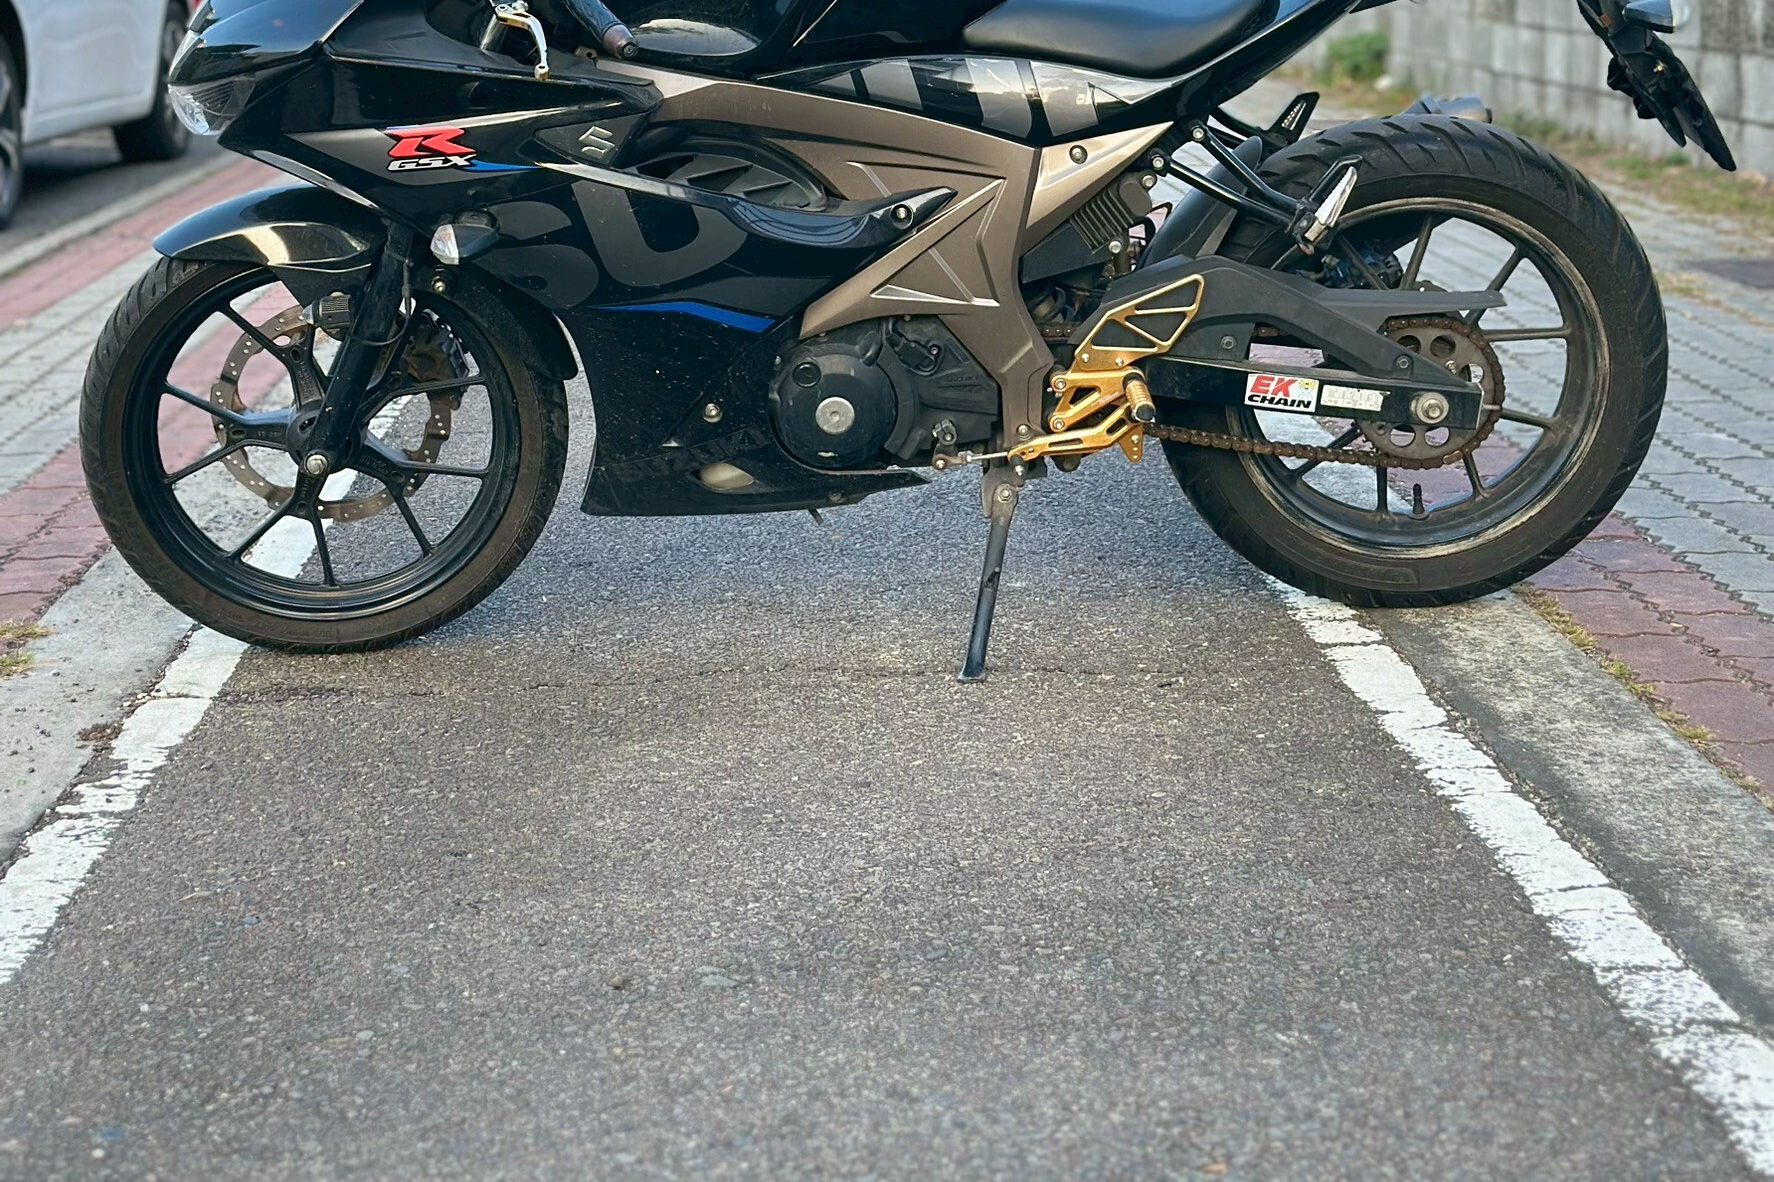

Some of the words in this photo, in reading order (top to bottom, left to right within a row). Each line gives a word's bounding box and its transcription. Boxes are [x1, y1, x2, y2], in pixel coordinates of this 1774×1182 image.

[384, 126, 477, 158] R
[387, 154, 477, 172] GSX
[1250, 375, 1298, 398] EK
[1247, 394, 1312, 409] CHAIN
